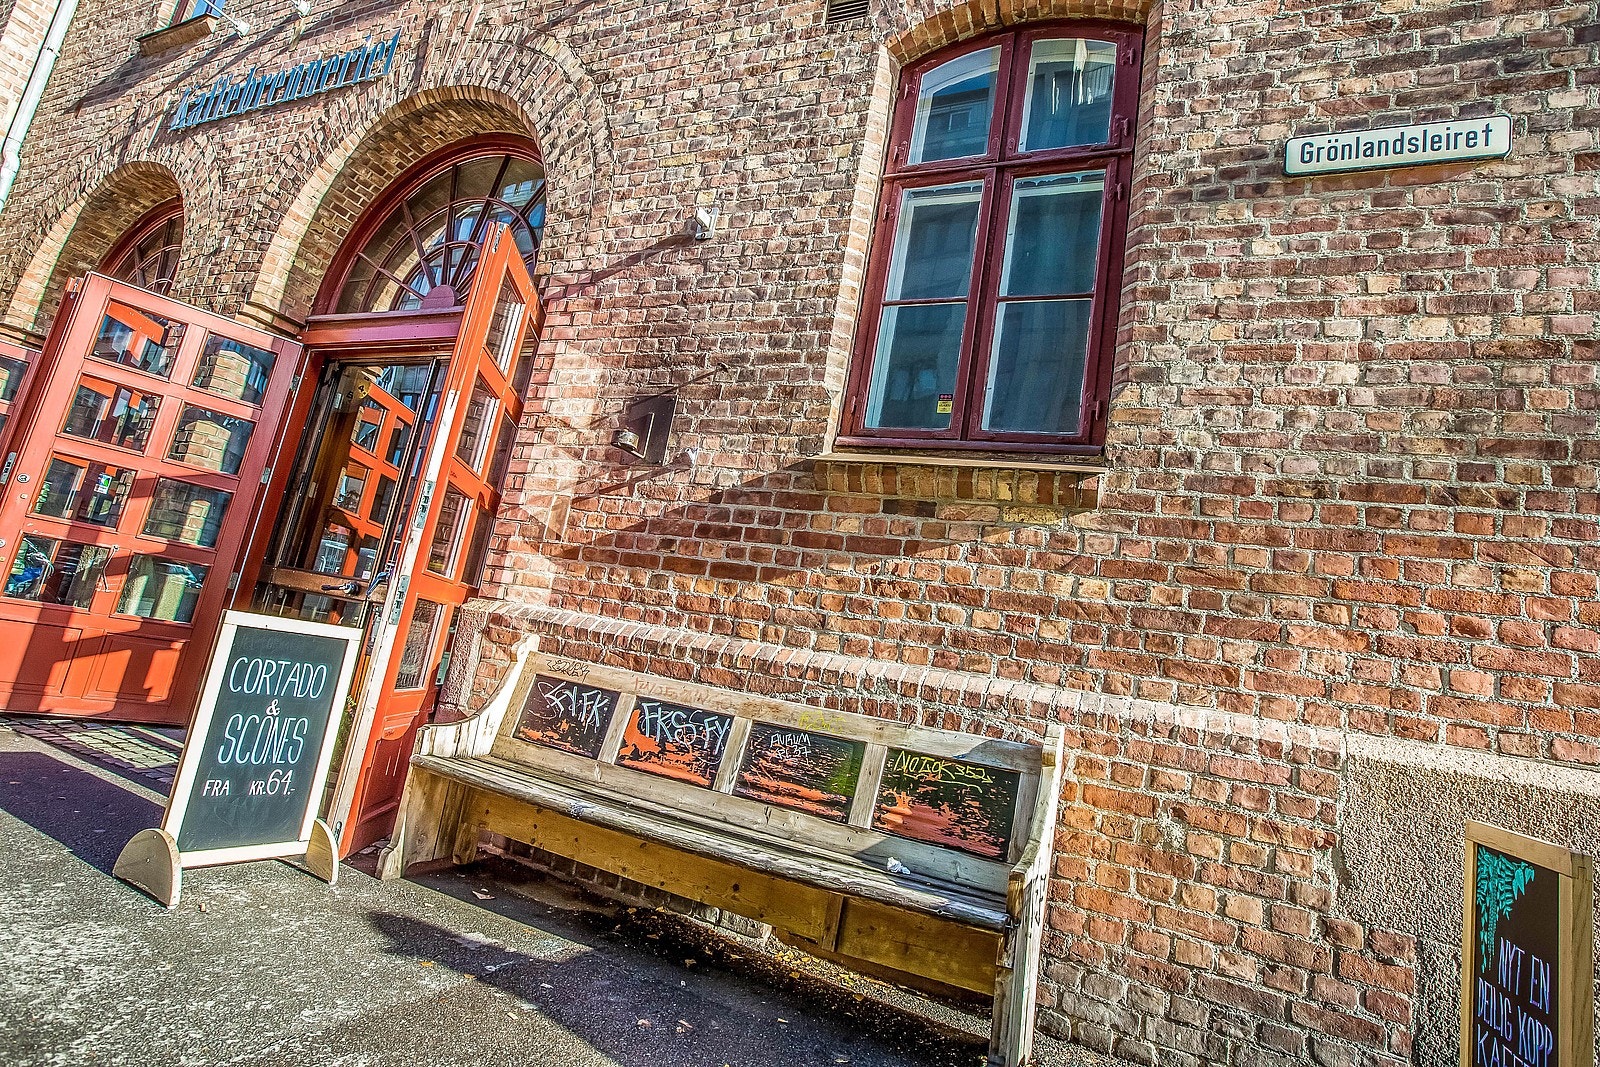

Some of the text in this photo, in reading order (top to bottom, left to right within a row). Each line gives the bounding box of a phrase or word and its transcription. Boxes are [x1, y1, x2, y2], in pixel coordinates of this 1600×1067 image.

[168, 27, 402, 131] Kaffebrenneriet
[1299, 122, 1493, 164] Grönlandsleiret
[228, 656, 328, 699] CORTADO
[265, 698, 281, 716] &
[217, 713, 309, 765] SCONES
[202, 779, 231, 797] FRA
[1497, 936, 1550, 1015] NYT EN
[1476, 976, 1554, 1067] DEILIG KOPP
